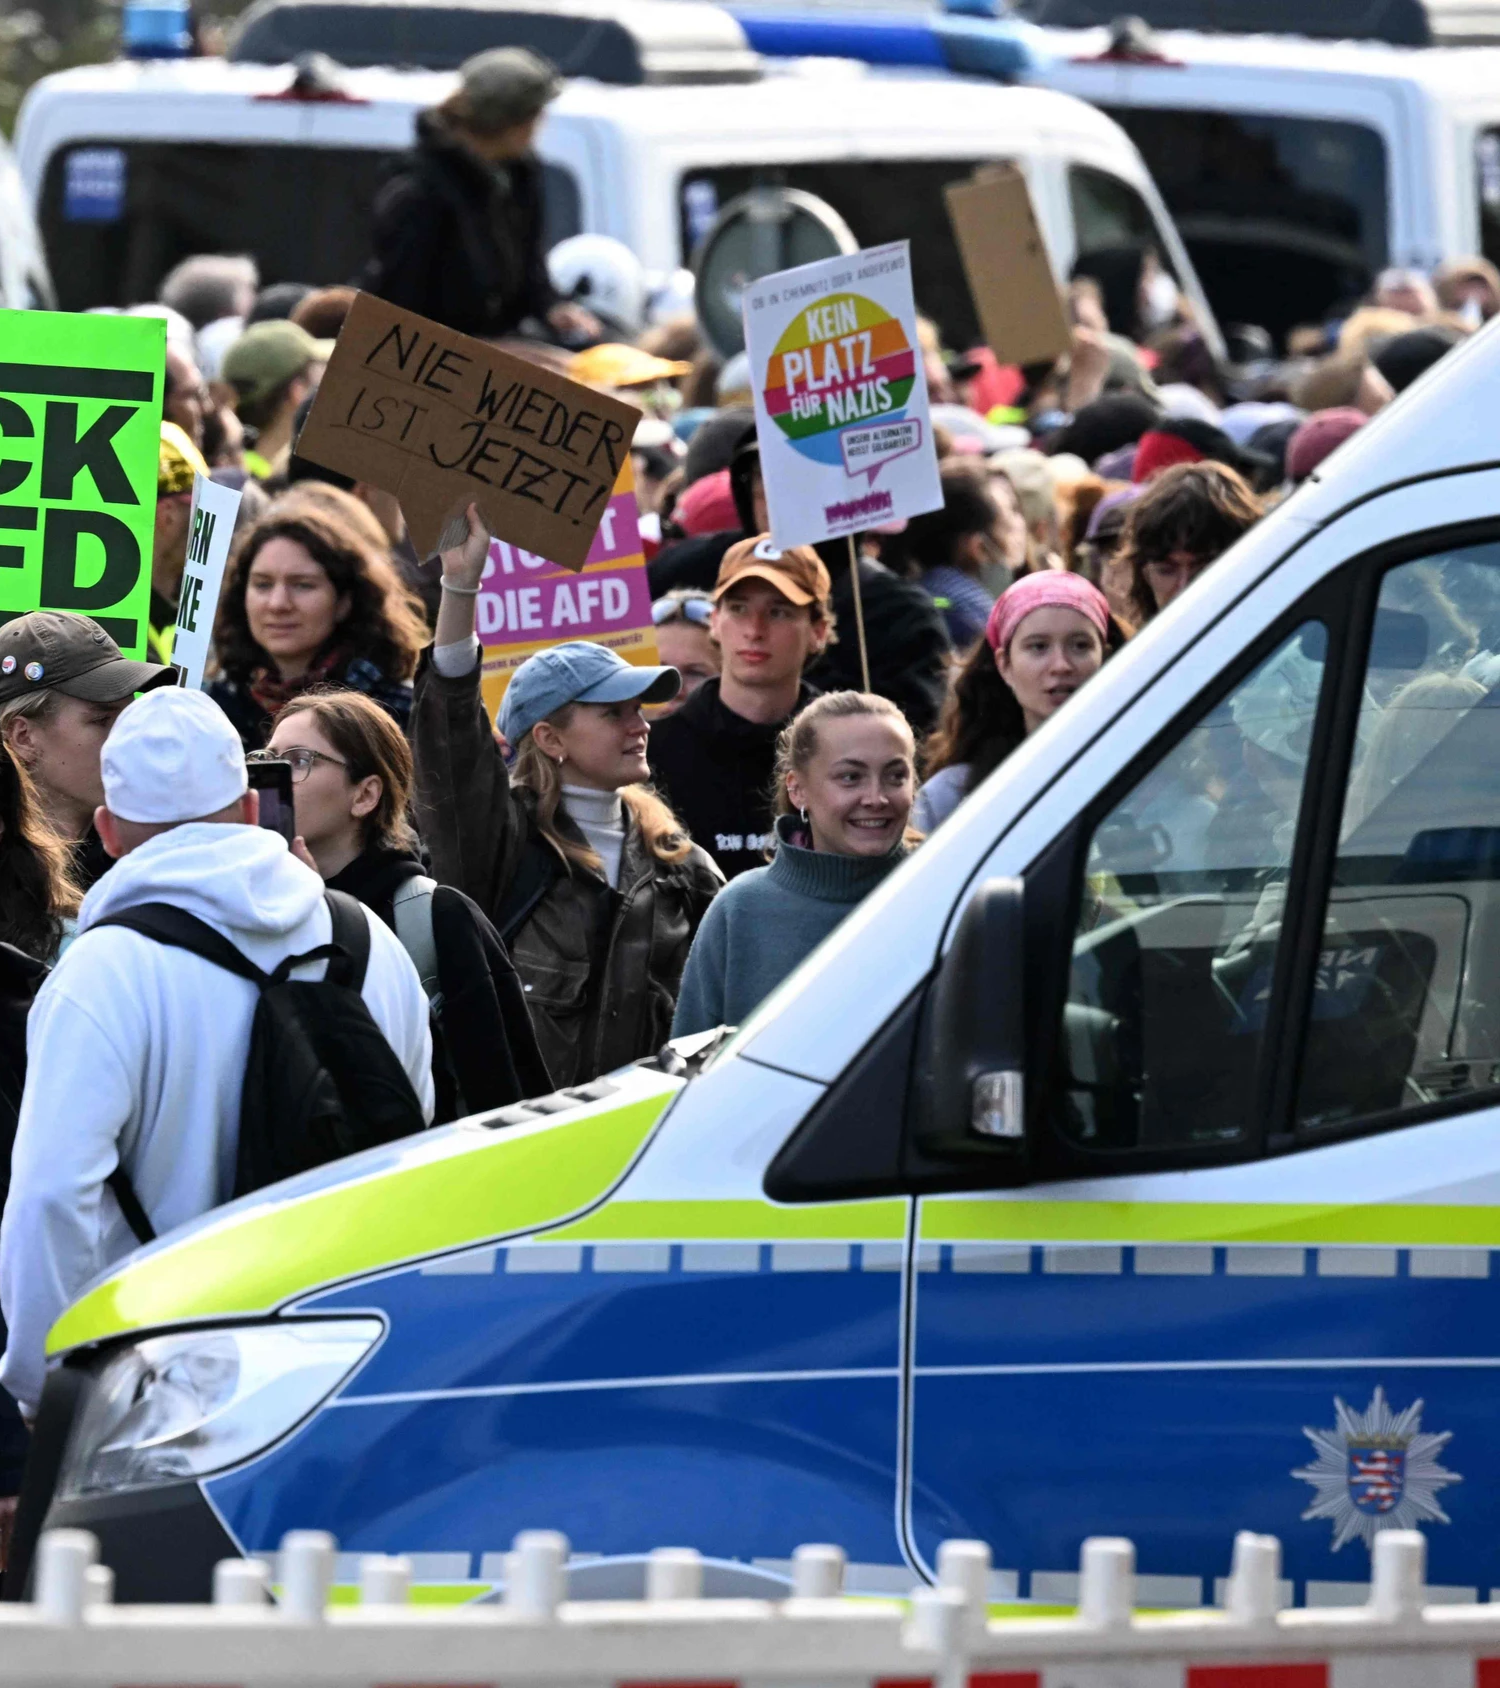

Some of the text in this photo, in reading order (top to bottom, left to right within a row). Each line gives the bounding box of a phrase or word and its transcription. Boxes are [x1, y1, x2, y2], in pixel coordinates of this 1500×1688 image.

[751, 296, 766, 310] OB
[769, 292, 780, 305] IN
[783, 279, 828, 302] CHEMNITZ
[858, 256, 906, 280] ANDERSWO
[805, 298, 858, 342] KEIN
[782, 331, 876, 397] PLATZ
[365, 323, 624, 476] NIE WIEDER
[790, 376, 893, 427] FÜR NAZIS
[346, 387, 610, 527] IST JETZT!
[477, 577, 631, 635] DIE AFD
